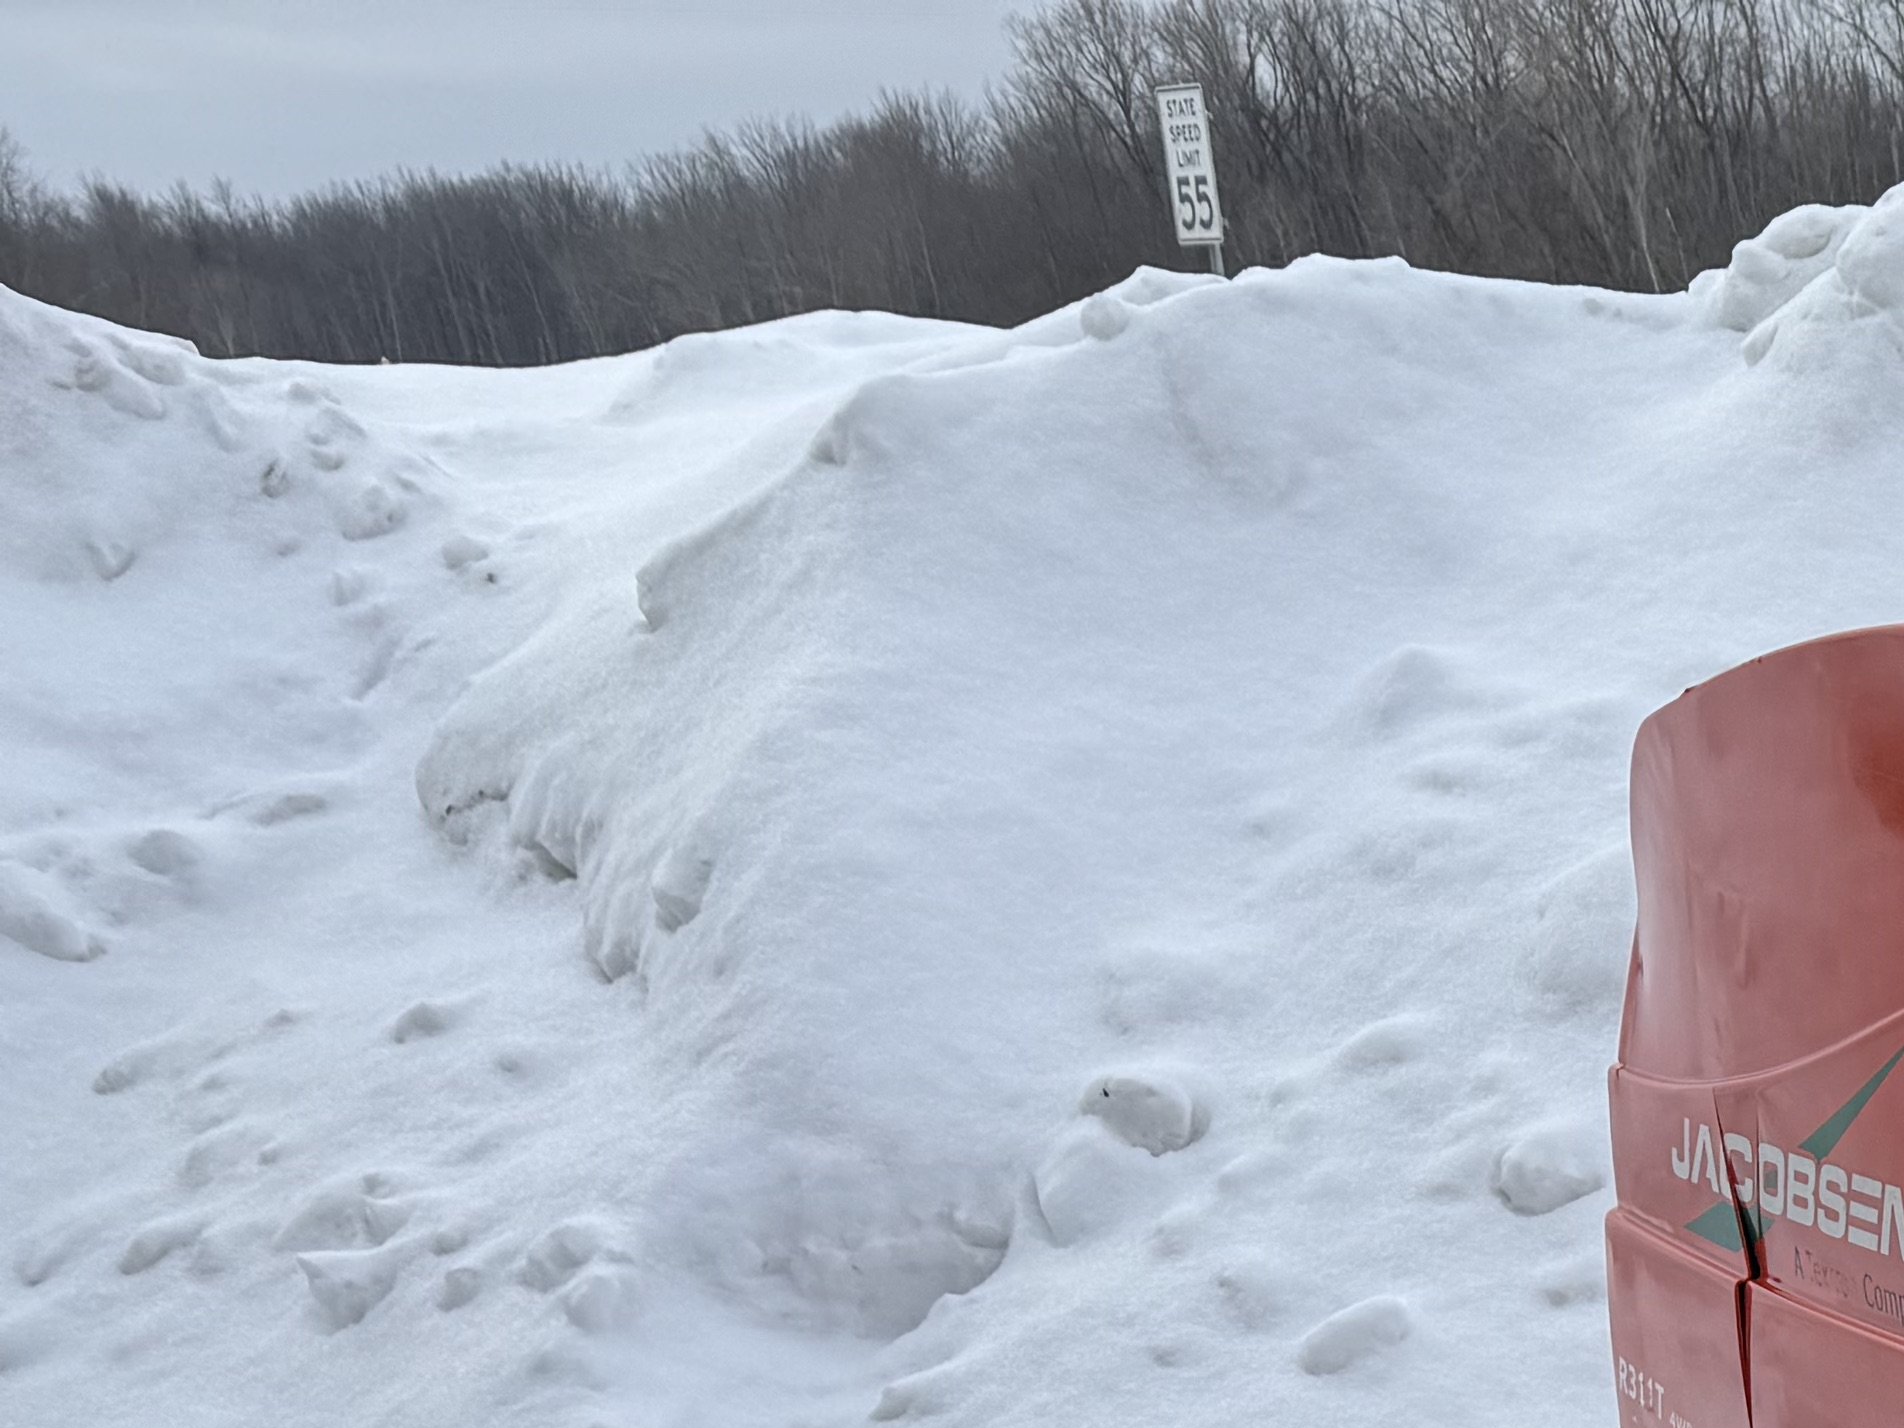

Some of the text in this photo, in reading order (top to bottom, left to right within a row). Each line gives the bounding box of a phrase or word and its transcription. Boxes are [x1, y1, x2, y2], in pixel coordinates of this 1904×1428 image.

[1166, 97, 1197, 118] STATE
[1169, 123, 1202, 143] SPEED
[1176, 149, 1202, 168] LIMIT
[1176, 175, 1214, 231] 55
[1619, 1356, 1665, 1420] R311T
